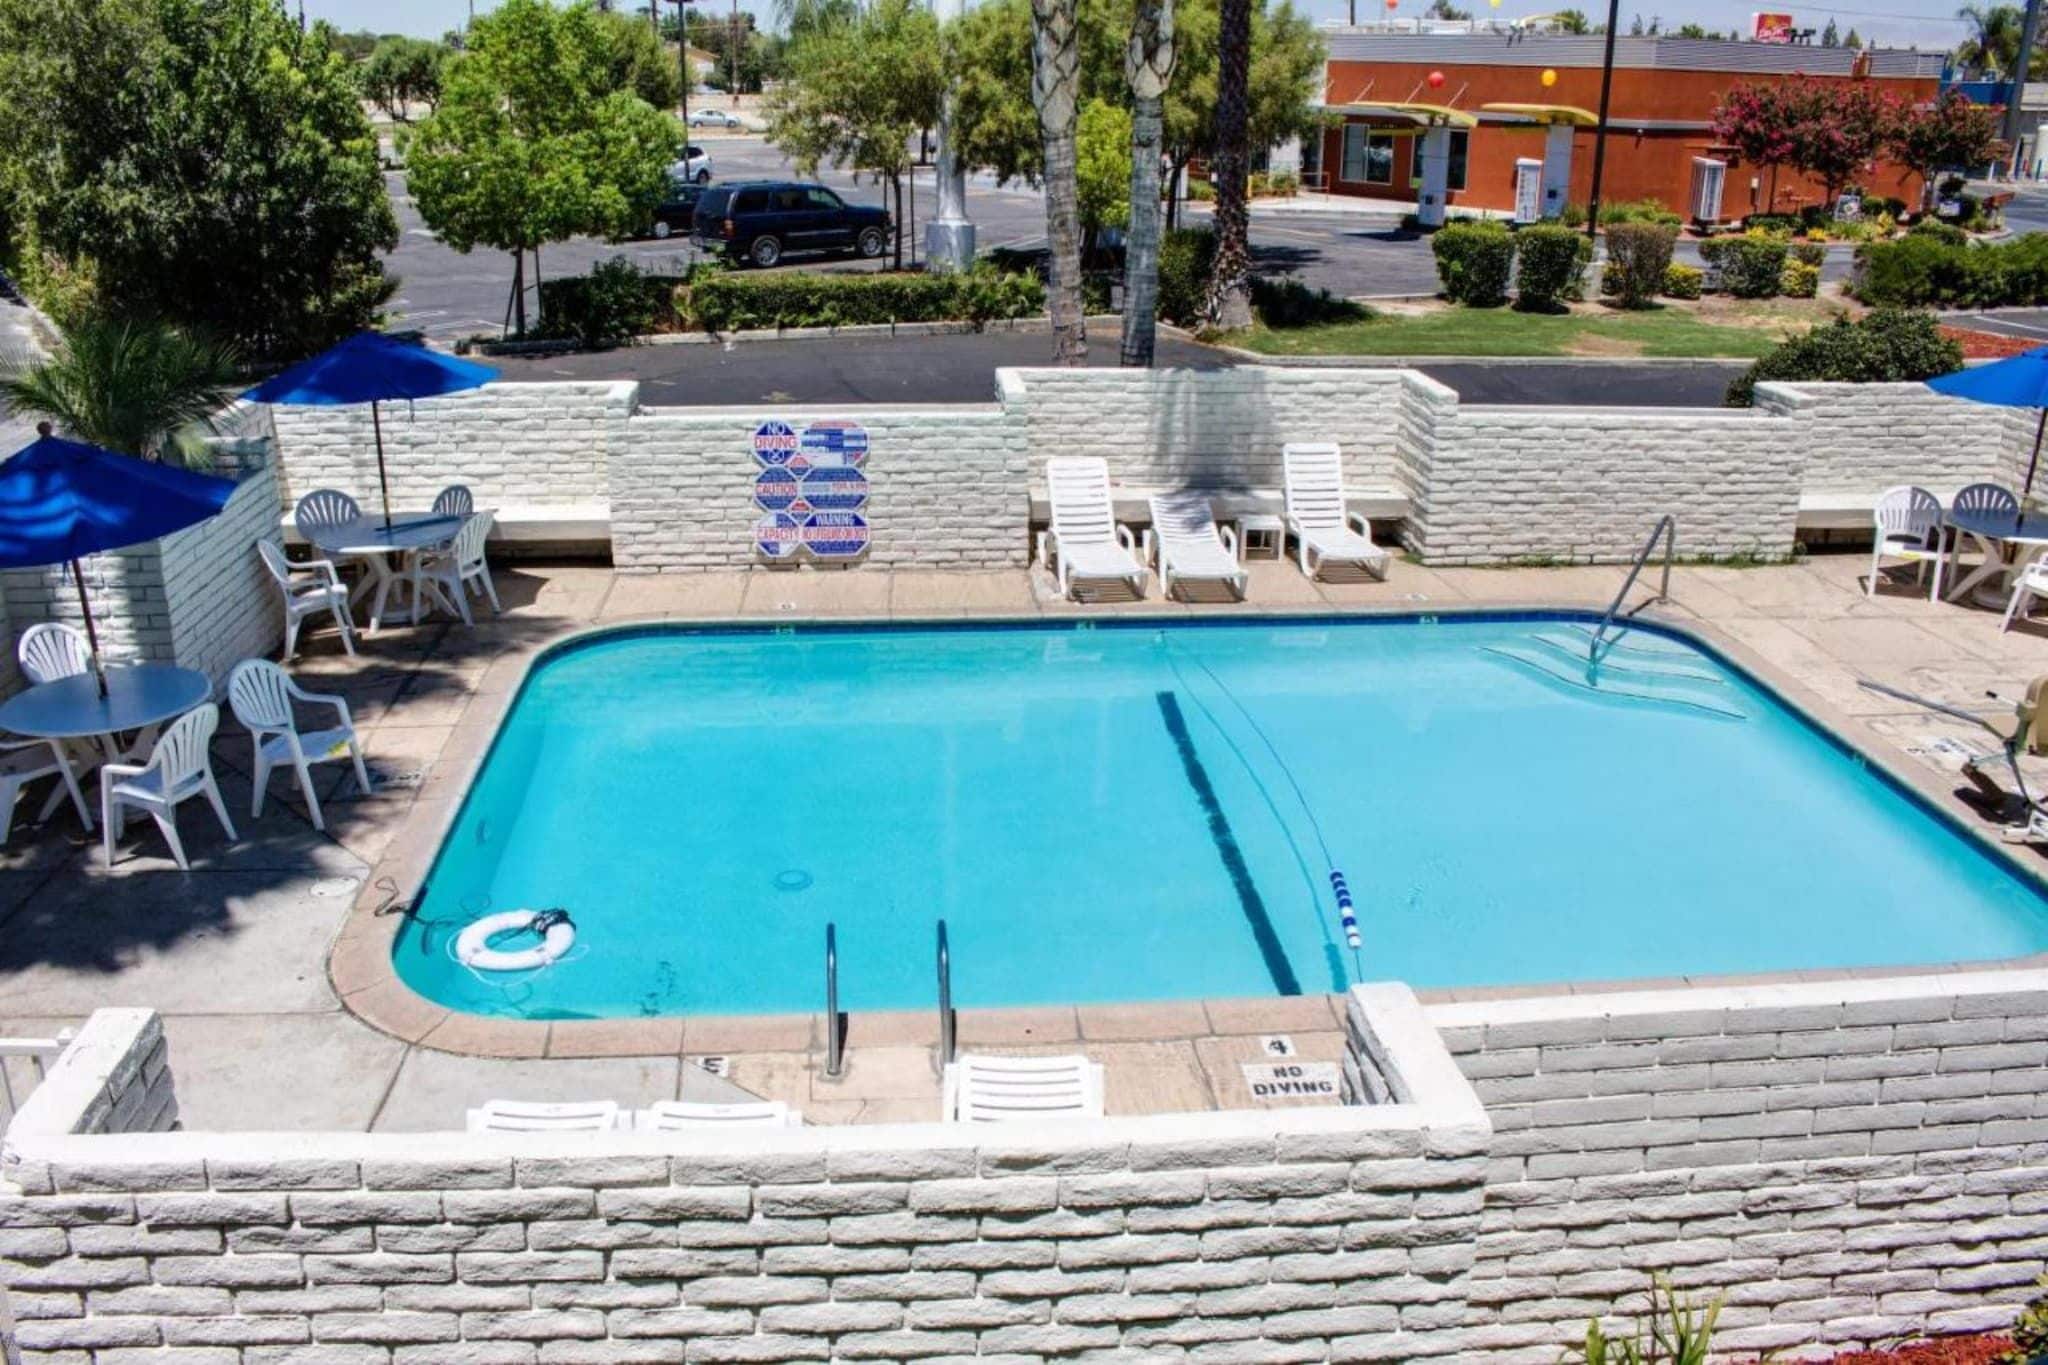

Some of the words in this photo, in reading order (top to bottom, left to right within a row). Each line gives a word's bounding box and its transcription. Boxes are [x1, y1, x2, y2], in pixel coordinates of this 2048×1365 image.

[767, 421, 785, 436] NO
[755, 436, 796, 449] DIVING
[755, 484, 797, 495] CAUTION
[815, 513, 853, 526] WARNING
[1269, 1040, 1287, 1054] 4
[1273, 1066, 1303, 1078] NO
[1253, 1081, 1332, 1095] DIVING
